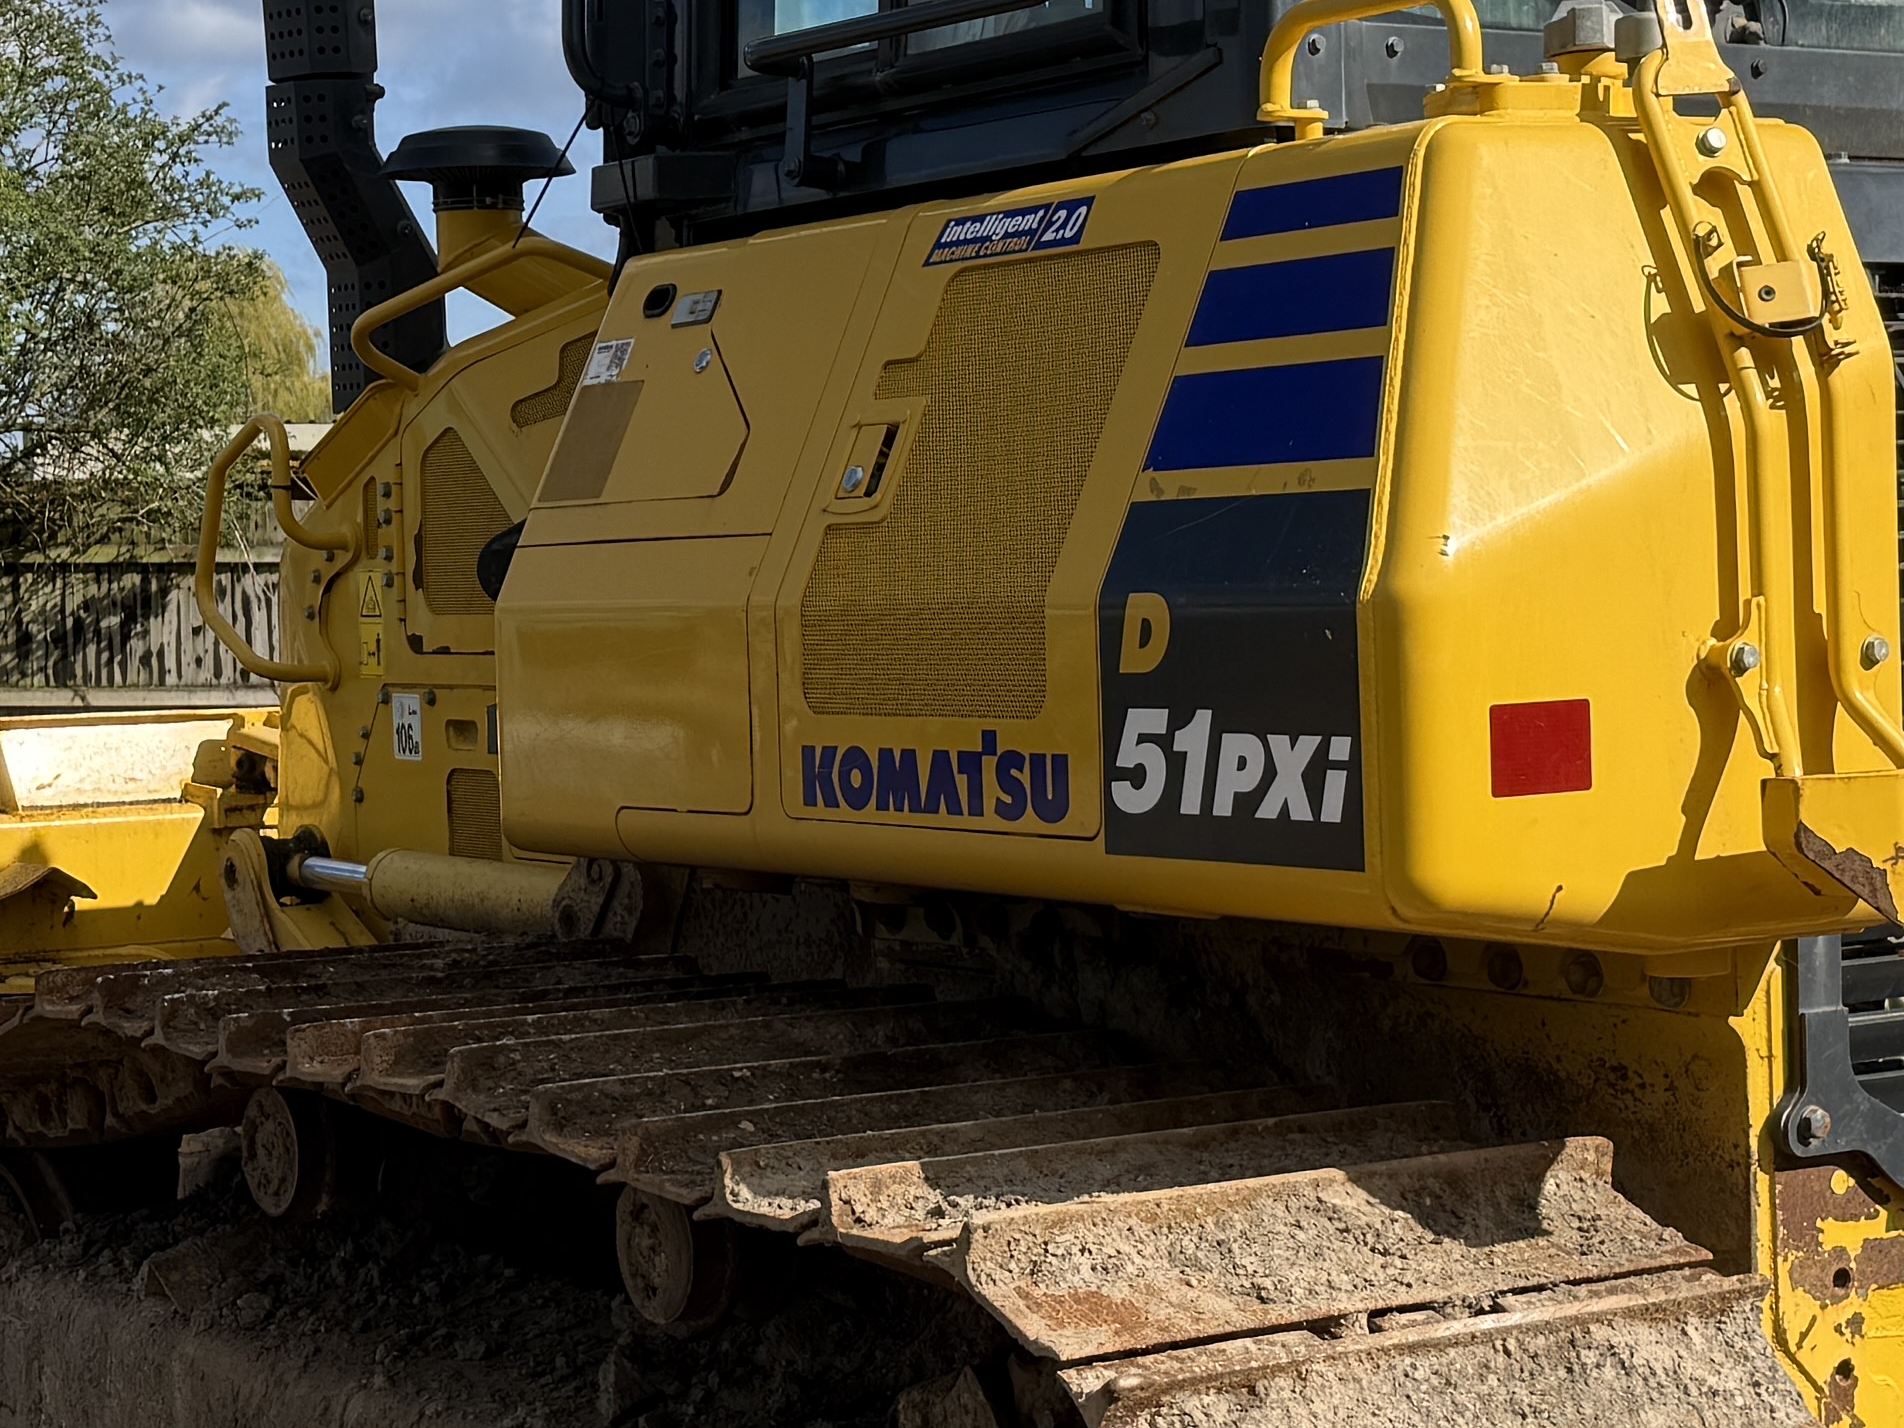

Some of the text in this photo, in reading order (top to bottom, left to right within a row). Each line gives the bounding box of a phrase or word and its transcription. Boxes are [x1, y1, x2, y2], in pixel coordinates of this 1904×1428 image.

[930, 236, 1030, 263] MACHINE CONTROL
[941, 204, 1089, 242] intelligent 2.0
[1119, 592, 1170, 674] D
[396, 722, 414, 755] 106
[1111, 708, 1352, 823] 51PXi
[801, 729, 1070, 824] KOMATSU
